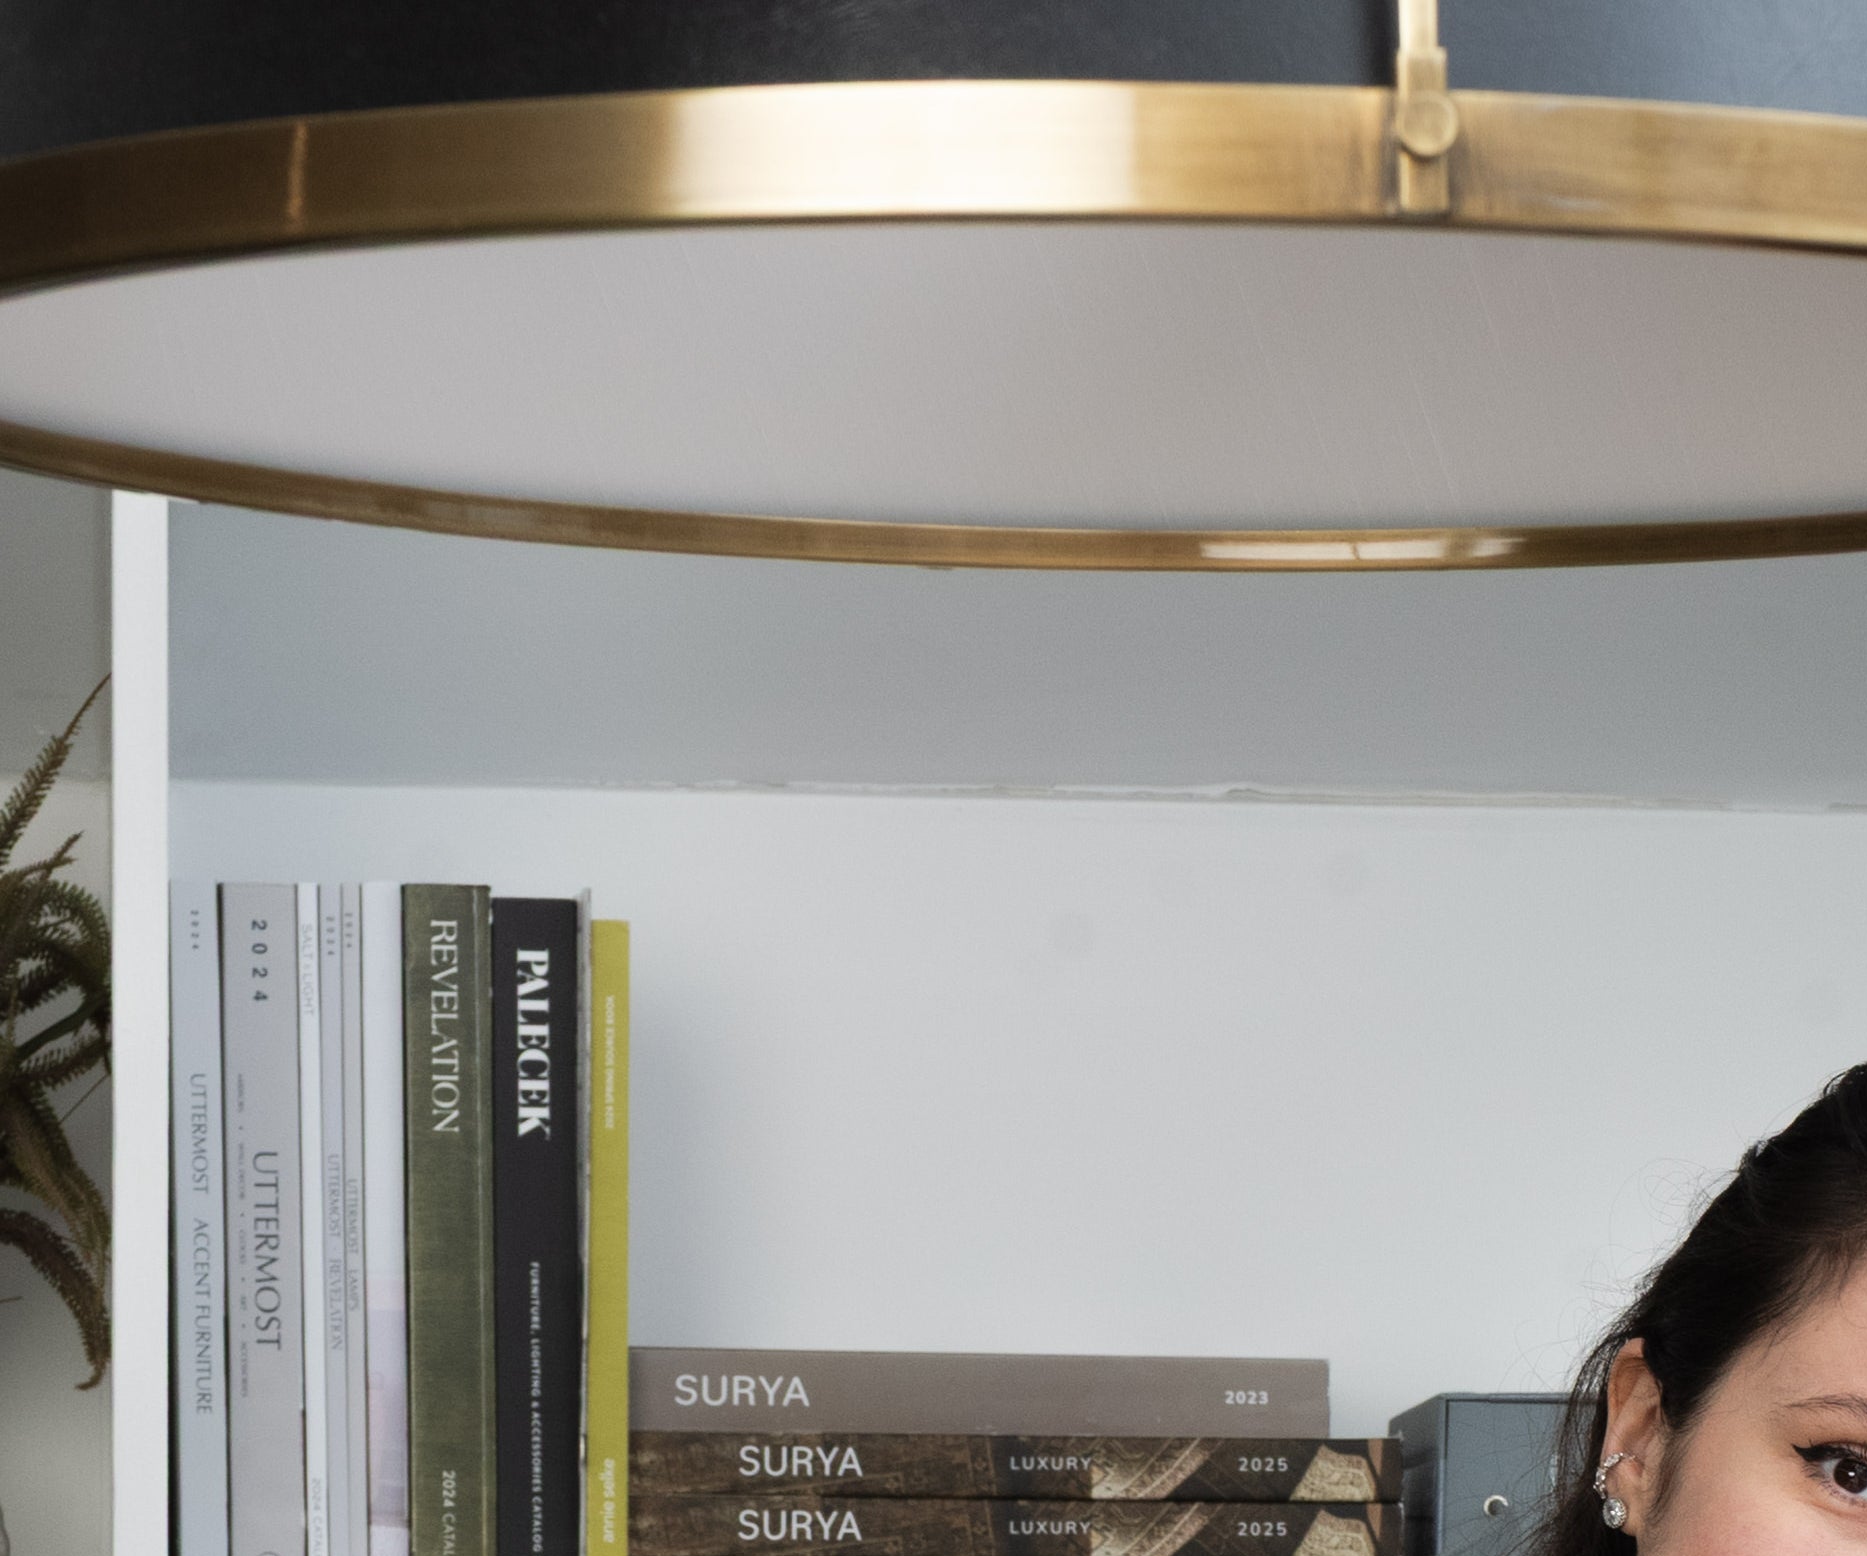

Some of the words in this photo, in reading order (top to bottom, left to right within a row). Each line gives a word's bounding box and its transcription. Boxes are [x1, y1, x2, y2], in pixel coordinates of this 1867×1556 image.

[430, 919, 459, 1133] REVELATION
[515, 948, 550, 1140] PALECEK
[188, 1073, 210, 1195] UTTERMOST
[329, 1153, 343, 1238] UTTERMOST
[193, 1217, 212, 1299] ACCENT
[252, 1151, 283, 1352] UTTERMOST
[195, 1305, 214, 1415] FURNITURE
[530, 1338, 542, 1396] LIGHTING
[674, 1374, 811, 1408] SURYA
[1224, 1390, 1270, 1405] 2023
[442, 1470, 456, 1509] 2024
[530, 1411, 543, 1493] ACCESSORIES
[738, 1445, 863, 1477] SURYA
[1009, 1456, 1093, 1472] LUXURY
[1237, 1456, 1290, 1473] 2025
[531, 1496, 544, 1553] CATALOG
[737, 1509, 862, 1541] SURYA
[1009, 1520, 1093, 1536] LUXURY
[1236, 1521, 1288, 1537] 2025
